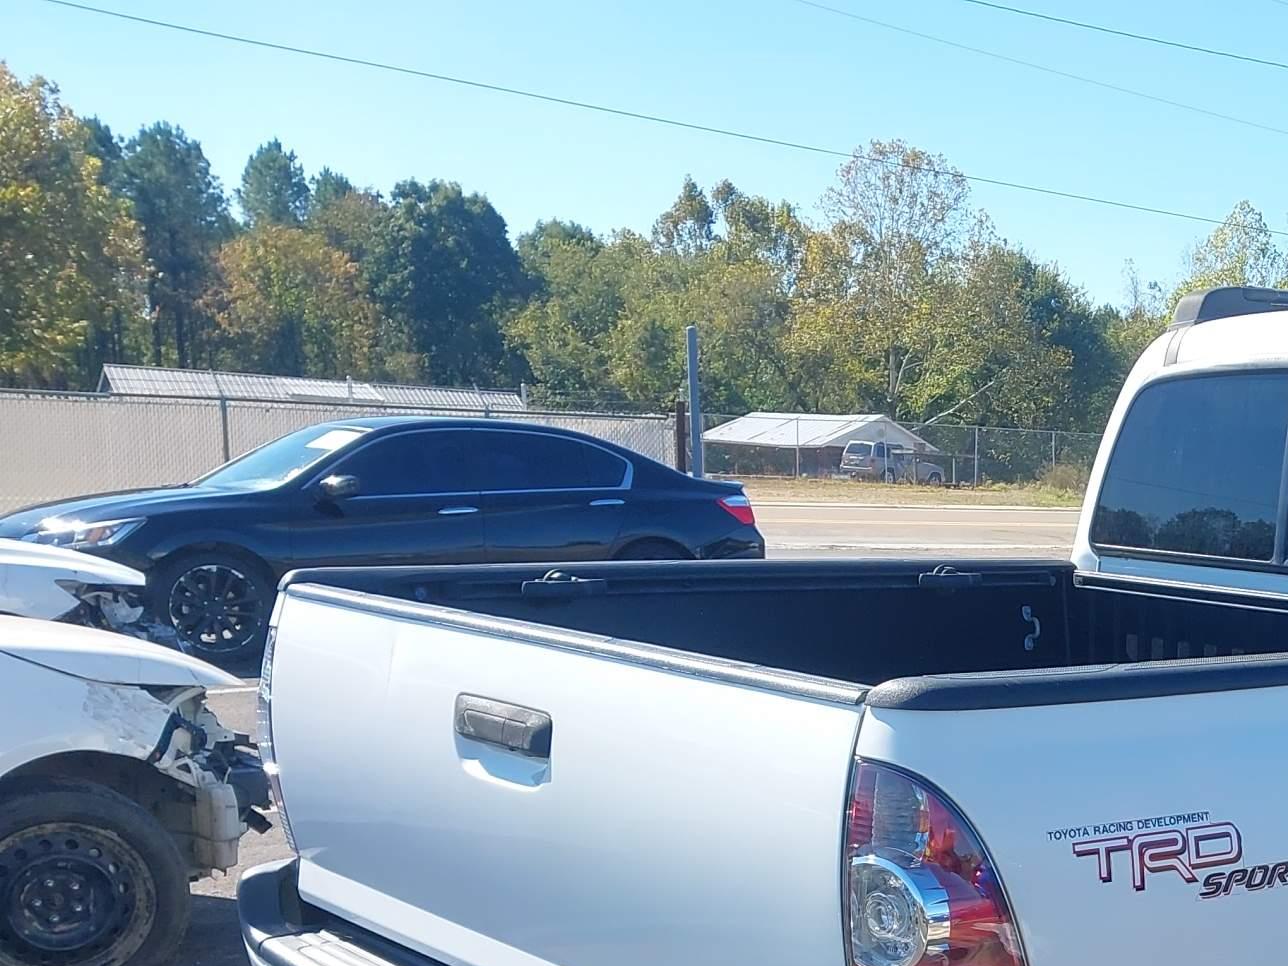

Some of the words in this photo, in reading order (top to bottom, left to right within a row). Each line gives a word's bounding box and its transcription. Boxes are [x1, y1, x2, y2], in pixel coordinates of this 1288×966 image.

[1048, 828, 1090, 841] TOYOTA
[1094, 822, 1134, 836] RACING
[1137, 811, 1210, 830] DEVELOPMENT
[1072, 821, 1243, 891] TRD
